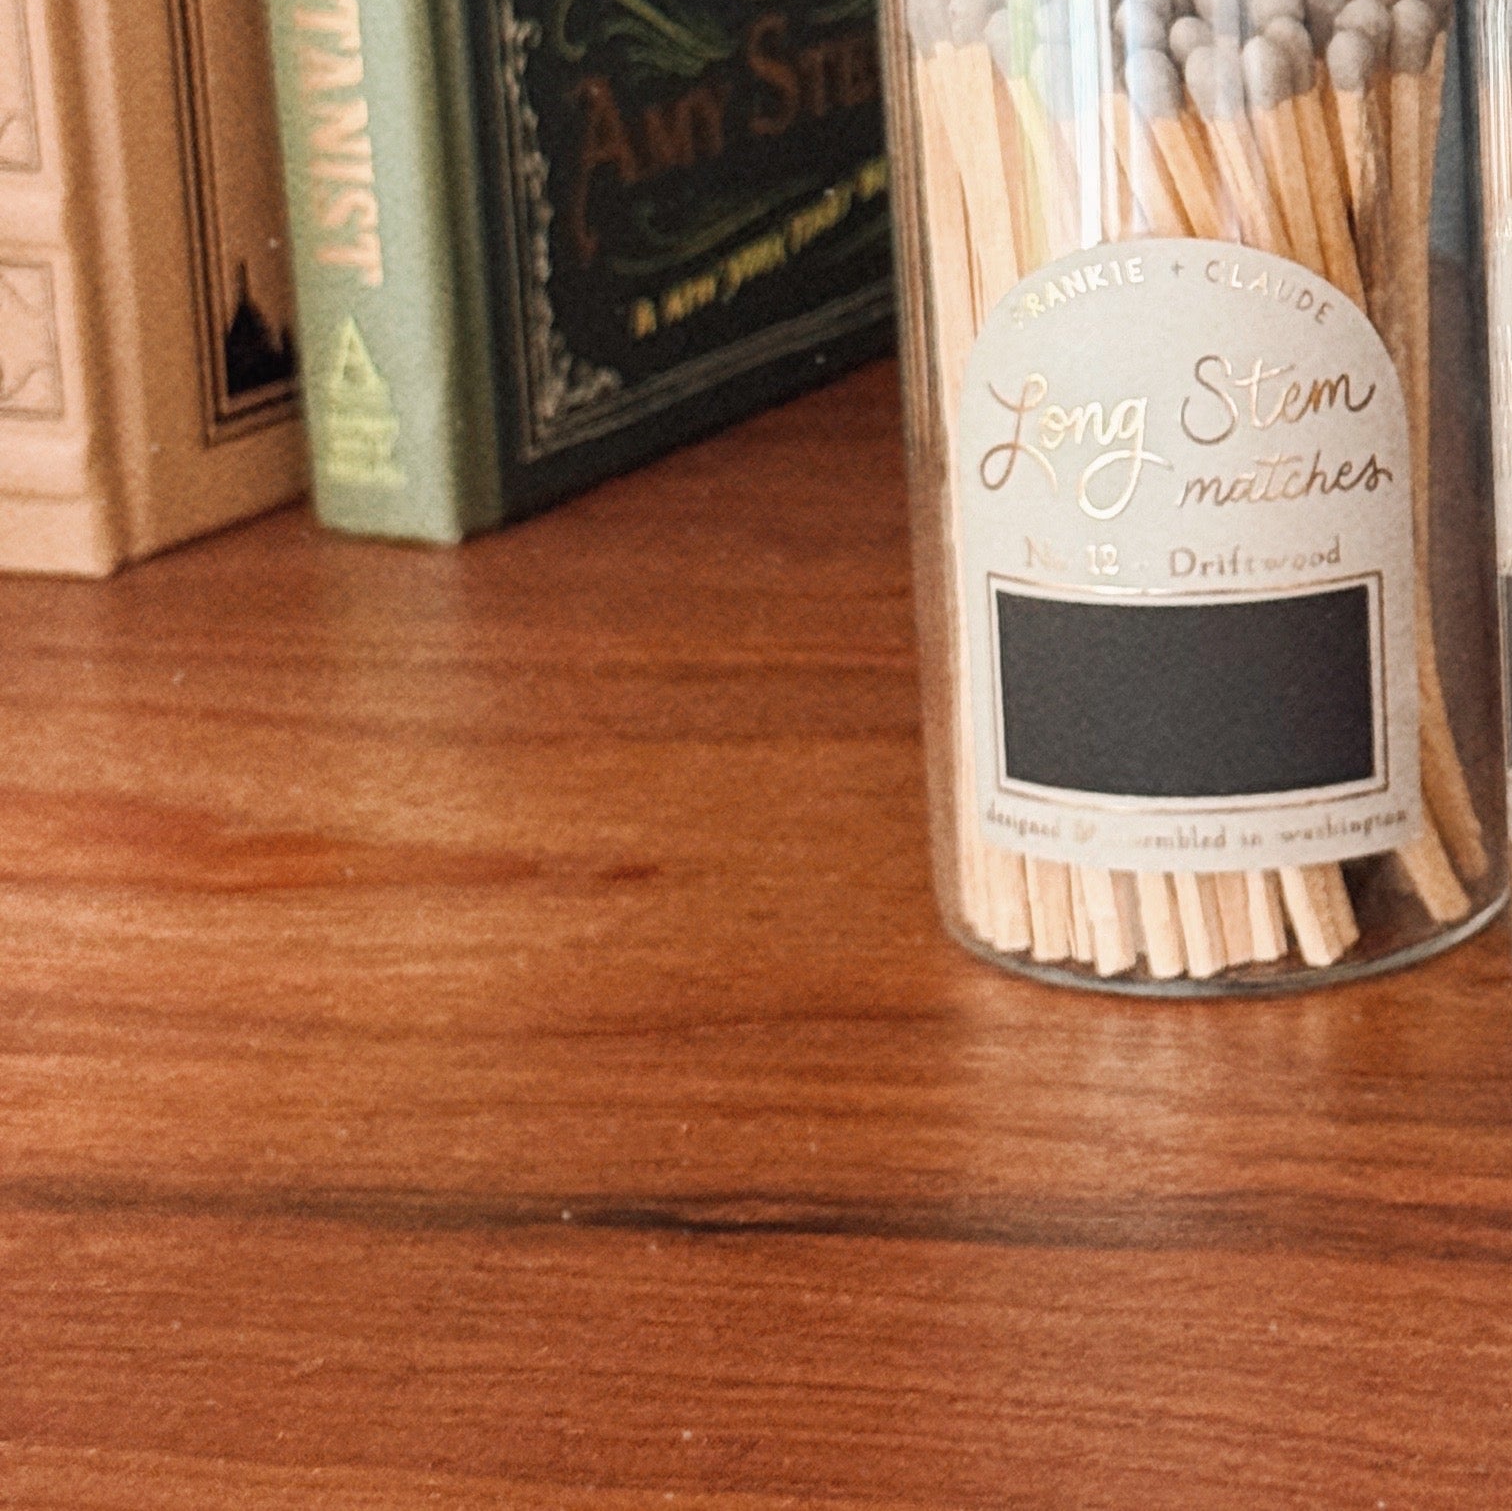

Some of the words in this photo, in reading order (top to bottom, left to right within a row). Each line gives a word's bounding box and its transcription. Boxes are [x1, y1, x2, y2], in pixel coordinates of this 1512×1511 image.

[1204, 258, 1336, 326] CLAUDE
[979, 371, 1175, 521] Long
[1180, 354, 1377, 446] Stem
[1175, 449, 1395, 508] matches
[1086, 543, 1120, 576] 12
[1169, 534, 1342, 578] Driftwood
